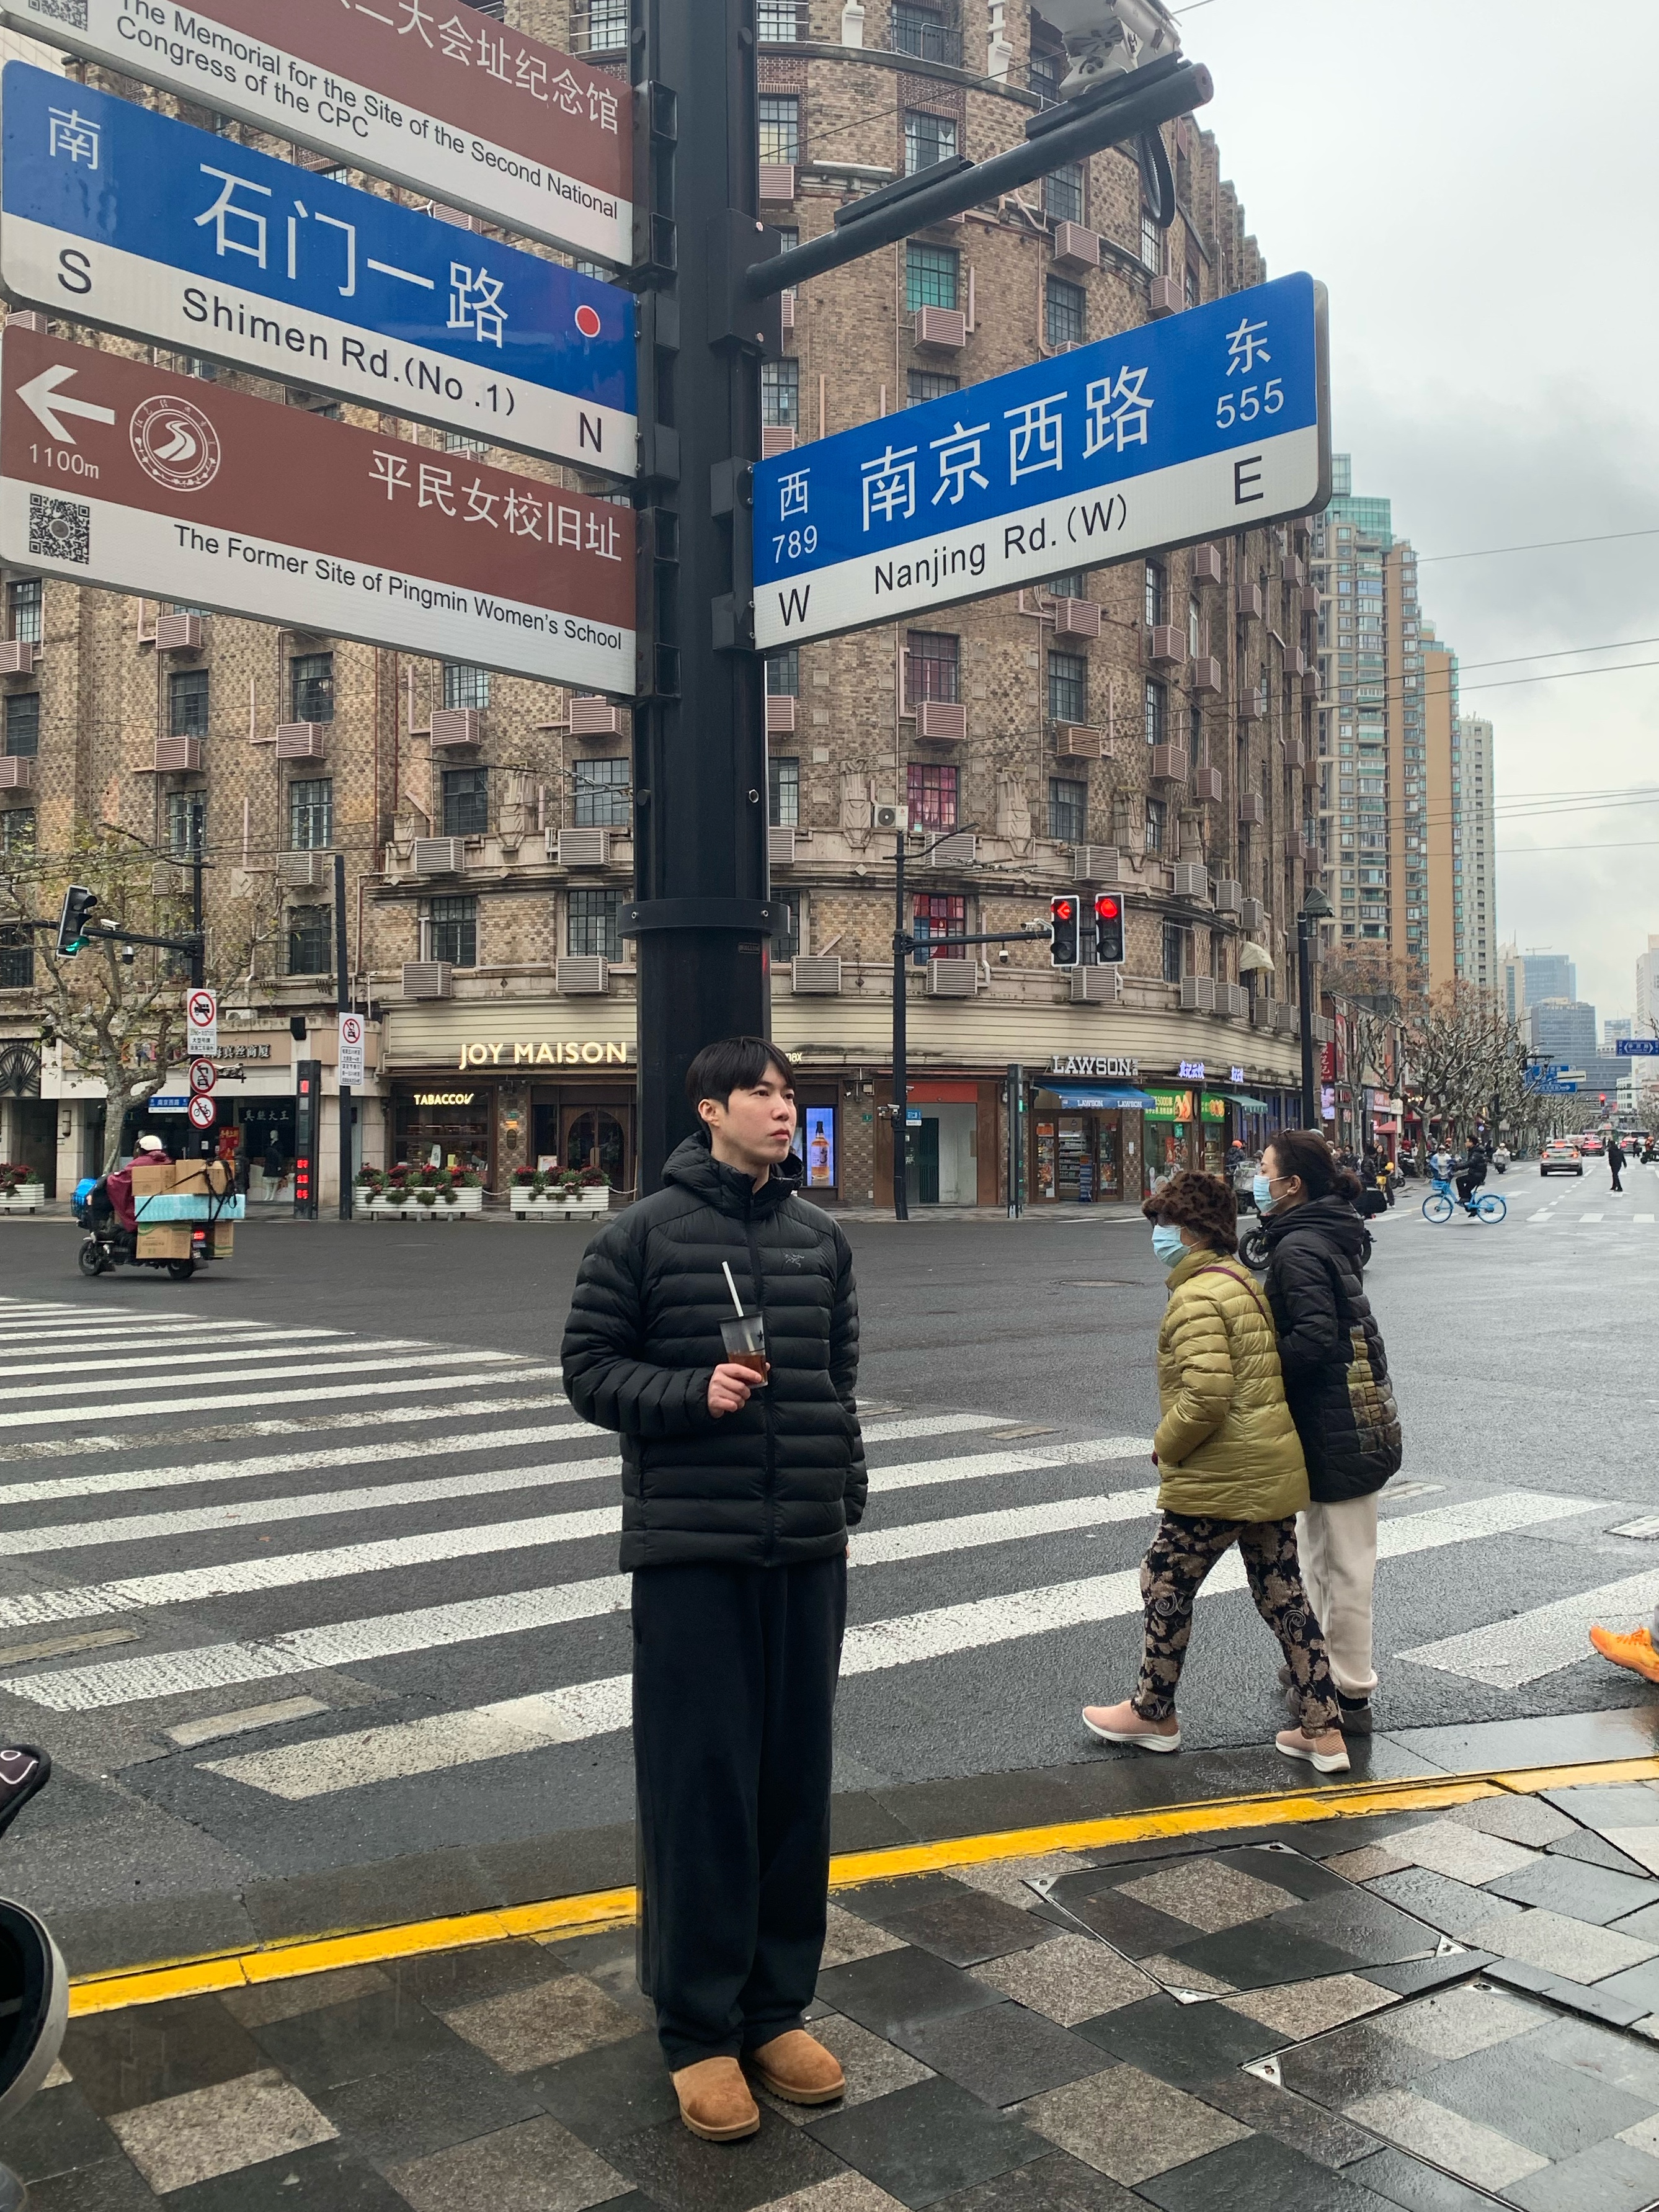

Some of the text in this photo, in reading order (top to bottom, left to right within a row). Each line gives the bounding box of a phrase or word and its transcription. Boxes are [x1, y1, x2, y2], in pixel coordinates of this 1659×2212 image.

[117, 16, 368, 138] Congress of the CPC
[48, 105, 100, 171] 南
[174, 10, 280, 76] Memorial
[288, 61, 318, 90] for
[323, 77, 357, 107] the
[364, 94, 403, 128] Site
[409, 119, 430, 145] of
[434, 125, 465, 154] the
[471, 141, 541, 187] Second
[548, 172, 618, 220] National
[57, 249, 92, 292] S
[193, 163, 509, 349] 石门一路
[182, 288, 327, 349] Shimen
[1226, 318, 1271, 375] 东
[1216, 377, 1285, 429] 555
[29, 443, 100, 479] 1100m
[578, 416, 603, 453] N
[861, 365, 1155, 532] 南京西路
[369, 449, 623, 562] 平民女校旧址
[778, 467, 810, 522] 西
[1234, 455, 1264, 506] E
[772, 524, 818, 563] 789
[875, 499, 1126, 595] Nanjing Rd. (W)
[174, 524, 219, 554] The
[228, 537, 309, 574] Former
[315, 559, 355, 586] Site
[362, 573, 383, 592] of
[389, 576, 467, 613] Pingmin
[564, 619, 621, 650] School
[778, 584, 811, 627] W
[459, 1041, 626, 1070] JOY MAISON
[1053, 1055, 1132, 1076] LAWSON
